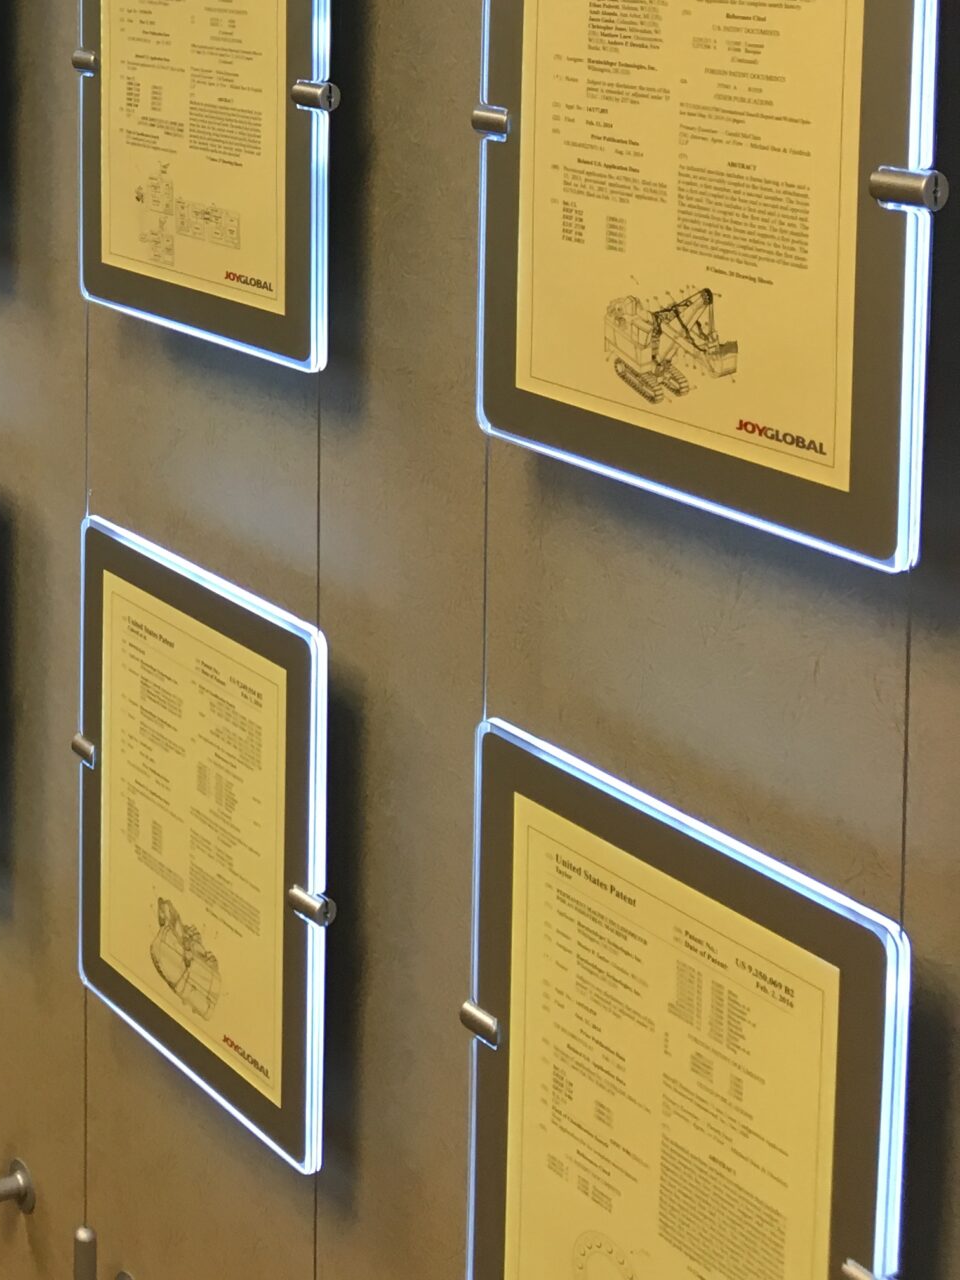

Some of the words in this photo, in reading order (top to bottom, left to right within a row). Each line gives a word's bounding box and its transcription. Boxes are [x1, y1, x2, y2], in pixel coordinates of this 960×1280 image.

[224, 270, 274, 293] JOYGLOBAL
[735, 419, 828, 457] JOYGLOBAL
[556, 853, 582, 876] United
[583, 869, 608, 891] States
[610, 884, 636, 907] Patent
[221, 1034, 271, 1079] JOYGLOBAL
